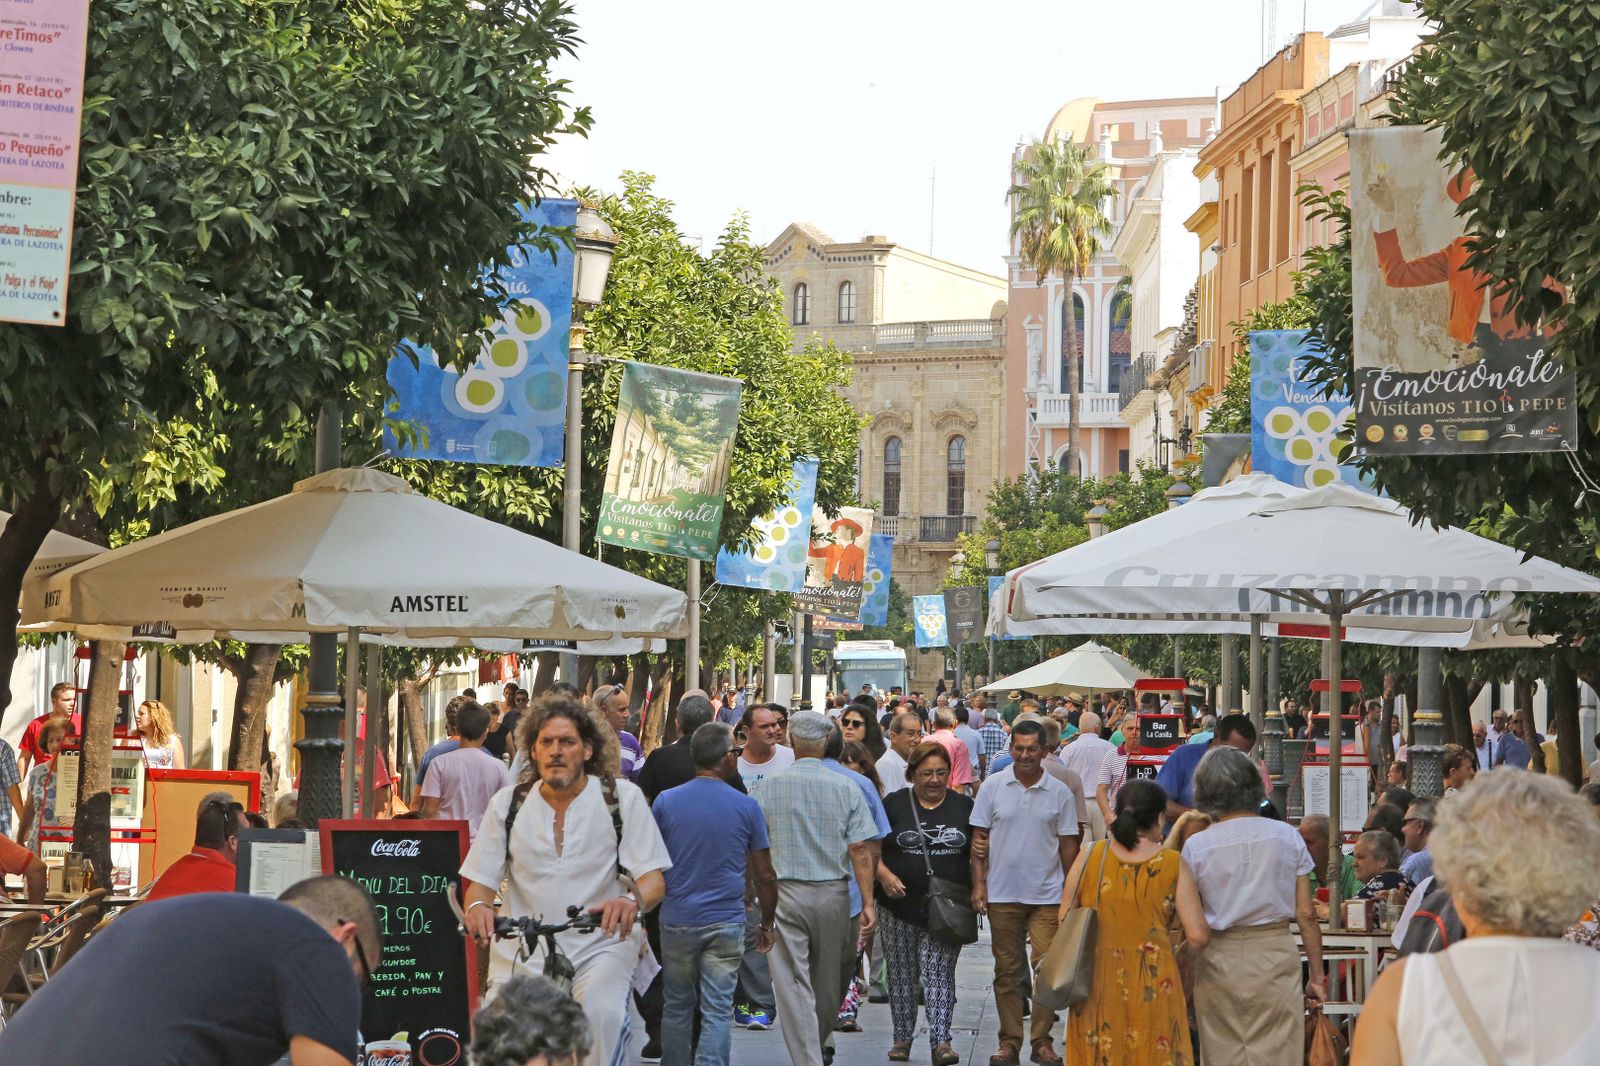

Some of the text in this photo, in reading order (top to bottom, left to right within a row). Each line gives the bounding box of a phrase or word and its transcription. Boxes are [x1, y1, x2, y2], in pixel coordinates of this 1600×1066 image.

[4, 43, 33, 53] Clowns
[33, 102, 42, 111] DE
[19, 158, 29, 167] DE
[31, 159, 65, 170] LAZOTEA
[14, 239, 25, 248] DE
[27, 240, 64, 251] LAZOTEA
[9, 290, 20, 299] DE
[22, 291, 58, 303] LAZOTEA
[1462, 399, 1498, 414] TIO
[1519, 397, 1568, 412] PEPE
[657, 521, 677, 533] TIO
[688, 527, 714, 540] PEPE
[389, 595, 468, 613] AMSTEL
[1152, 722, 1167, 730] Bar
[371, 838, 422, 858] Coca-Cola
[388, 876, 415, 894] DEL
[415, 971, 433, 981] PAN
[437, 970, 445, 981] Y
[374, 986, 397, 997] CAFÉ
[412, 986, 443, 996] POSTRE
